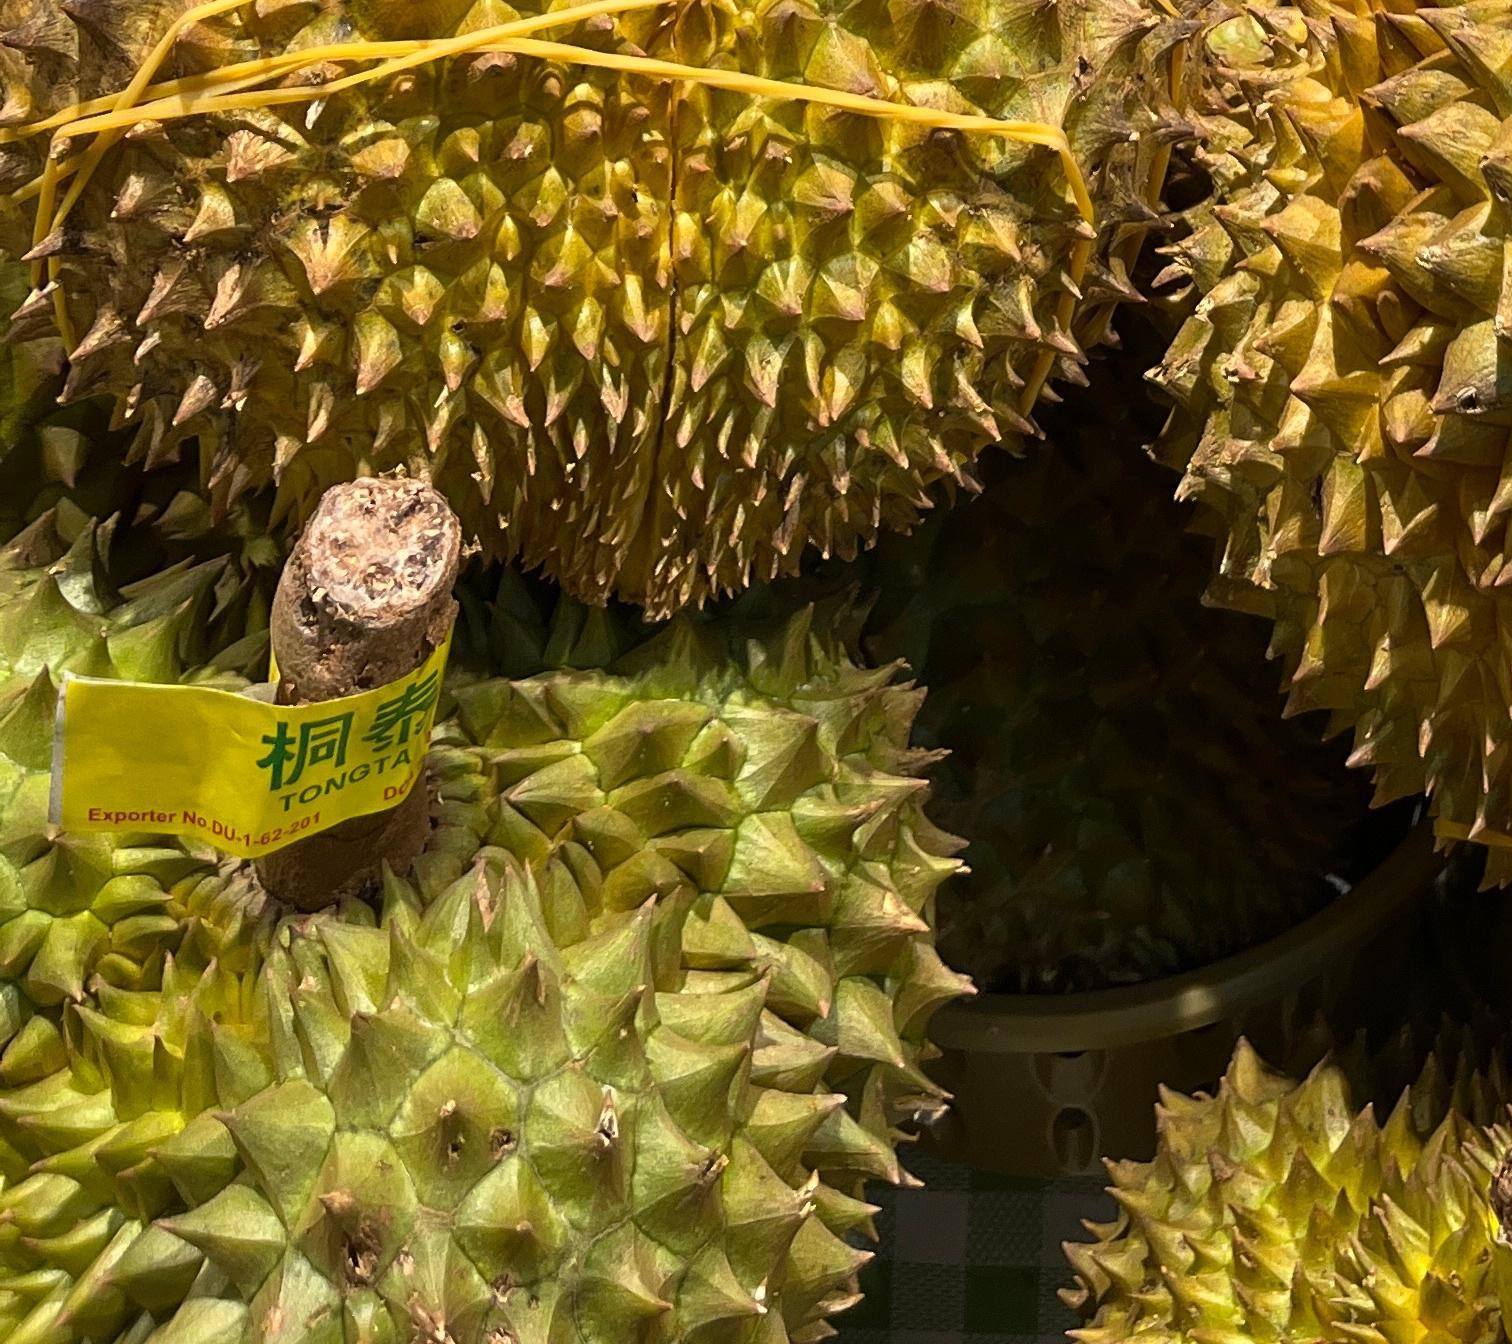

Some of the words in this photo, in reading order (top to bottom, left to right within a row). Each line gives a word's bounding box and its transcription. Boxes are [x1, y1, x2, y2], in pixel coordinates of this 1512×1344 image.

[256, 668, 440, 792] 桐泰
[281, 748, 412, 812] TONGTA
[88, 807, 176, 825] Exporter
